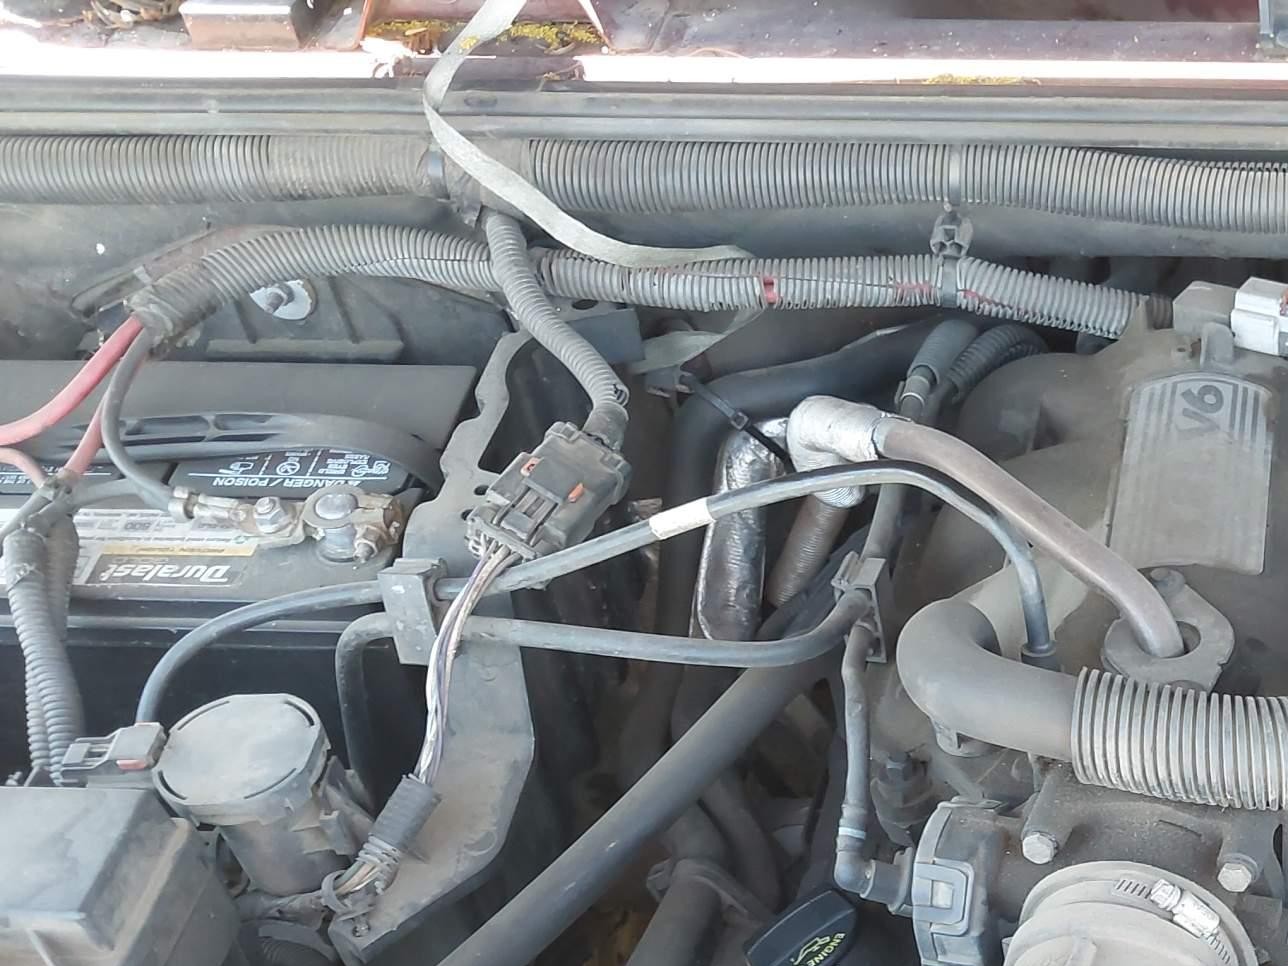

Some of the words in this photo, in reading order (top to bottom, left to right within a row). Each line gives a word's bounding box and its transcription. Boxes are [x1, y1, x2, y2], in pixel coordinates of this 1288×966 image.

[1177, 384, 1224, 432] V6
[213, 477, 267, 487] POISON
[100, 564, 231, 583] Duralast
